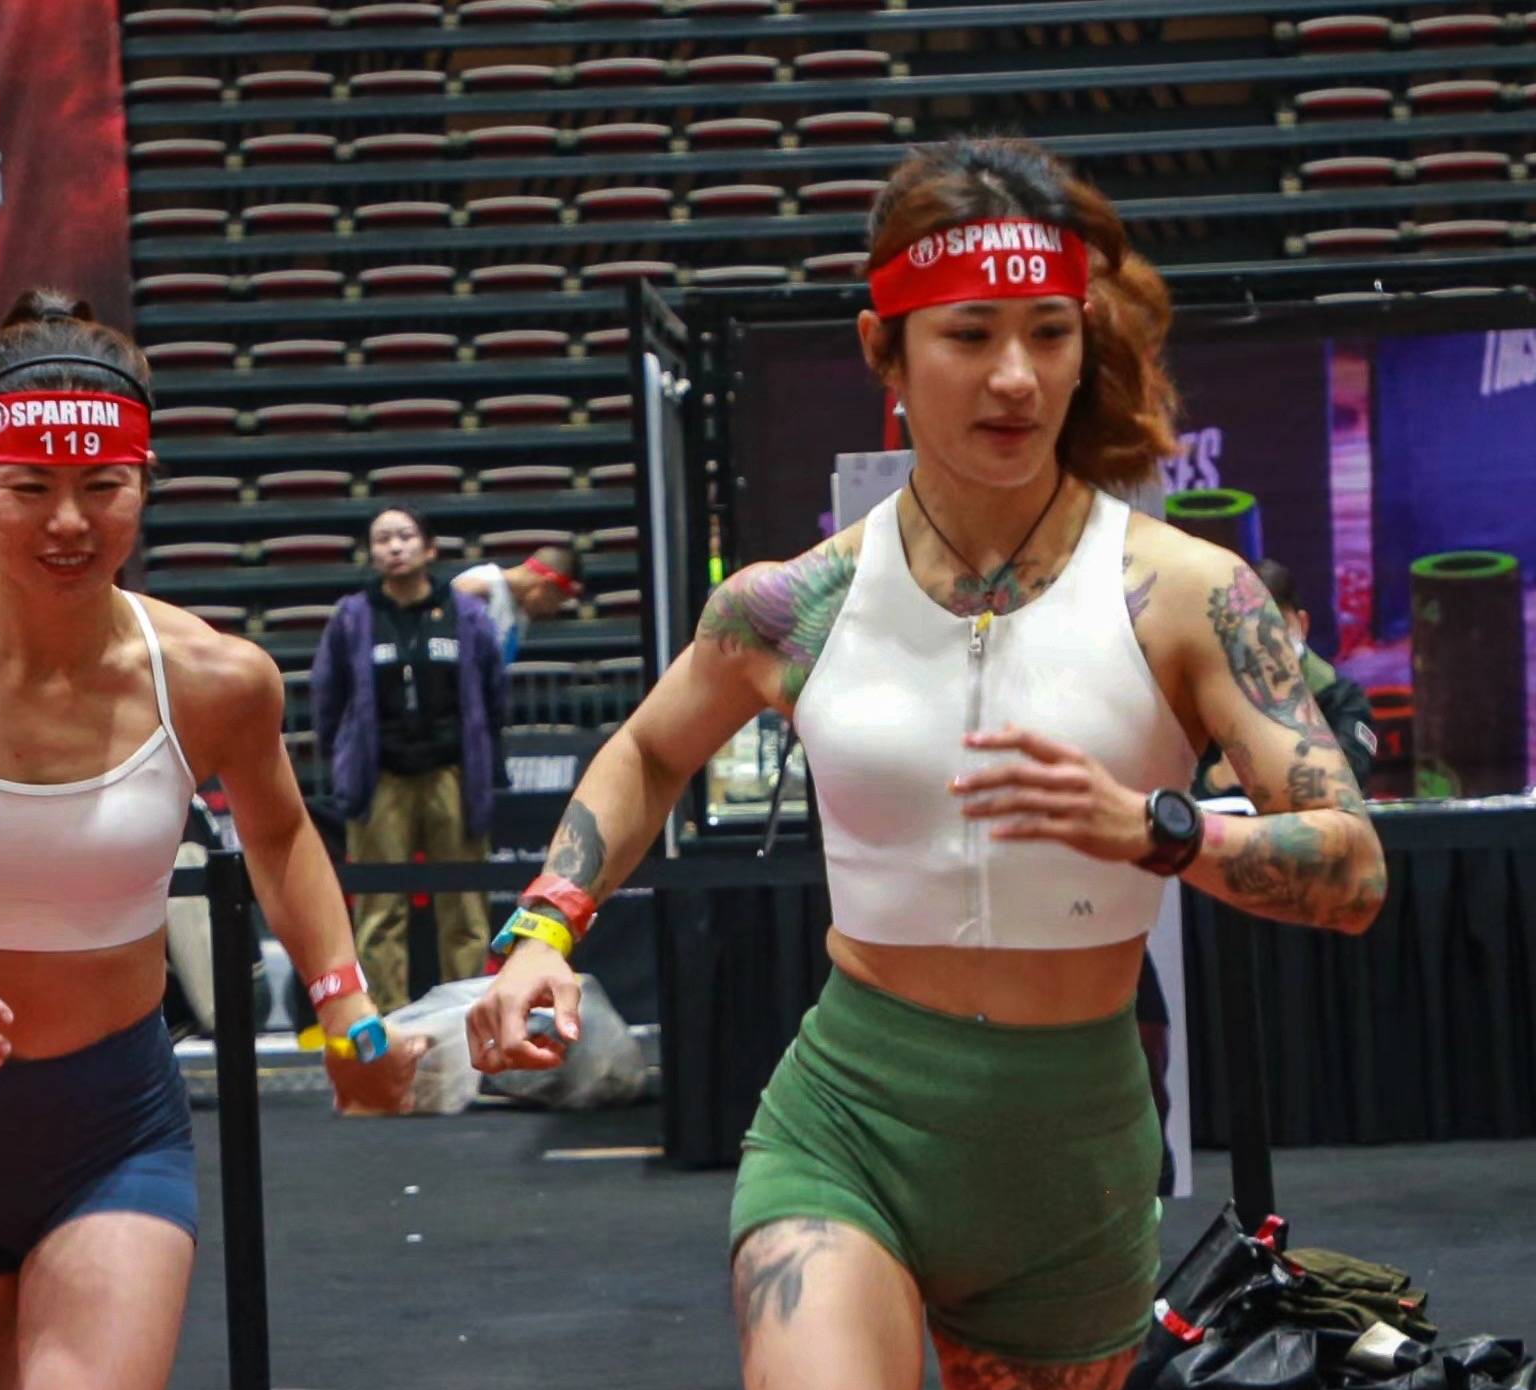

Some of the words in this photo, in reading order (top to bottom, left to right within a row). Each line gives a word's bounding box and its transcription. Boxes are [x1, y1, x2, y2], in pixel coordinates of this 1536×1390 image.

[946, 222, 1062, 256] SPARTAN
[980, 254, 1047, 285] 109
[10, 400, 120, 428] SPARTAN
[39, 430, 101, 456] 119
